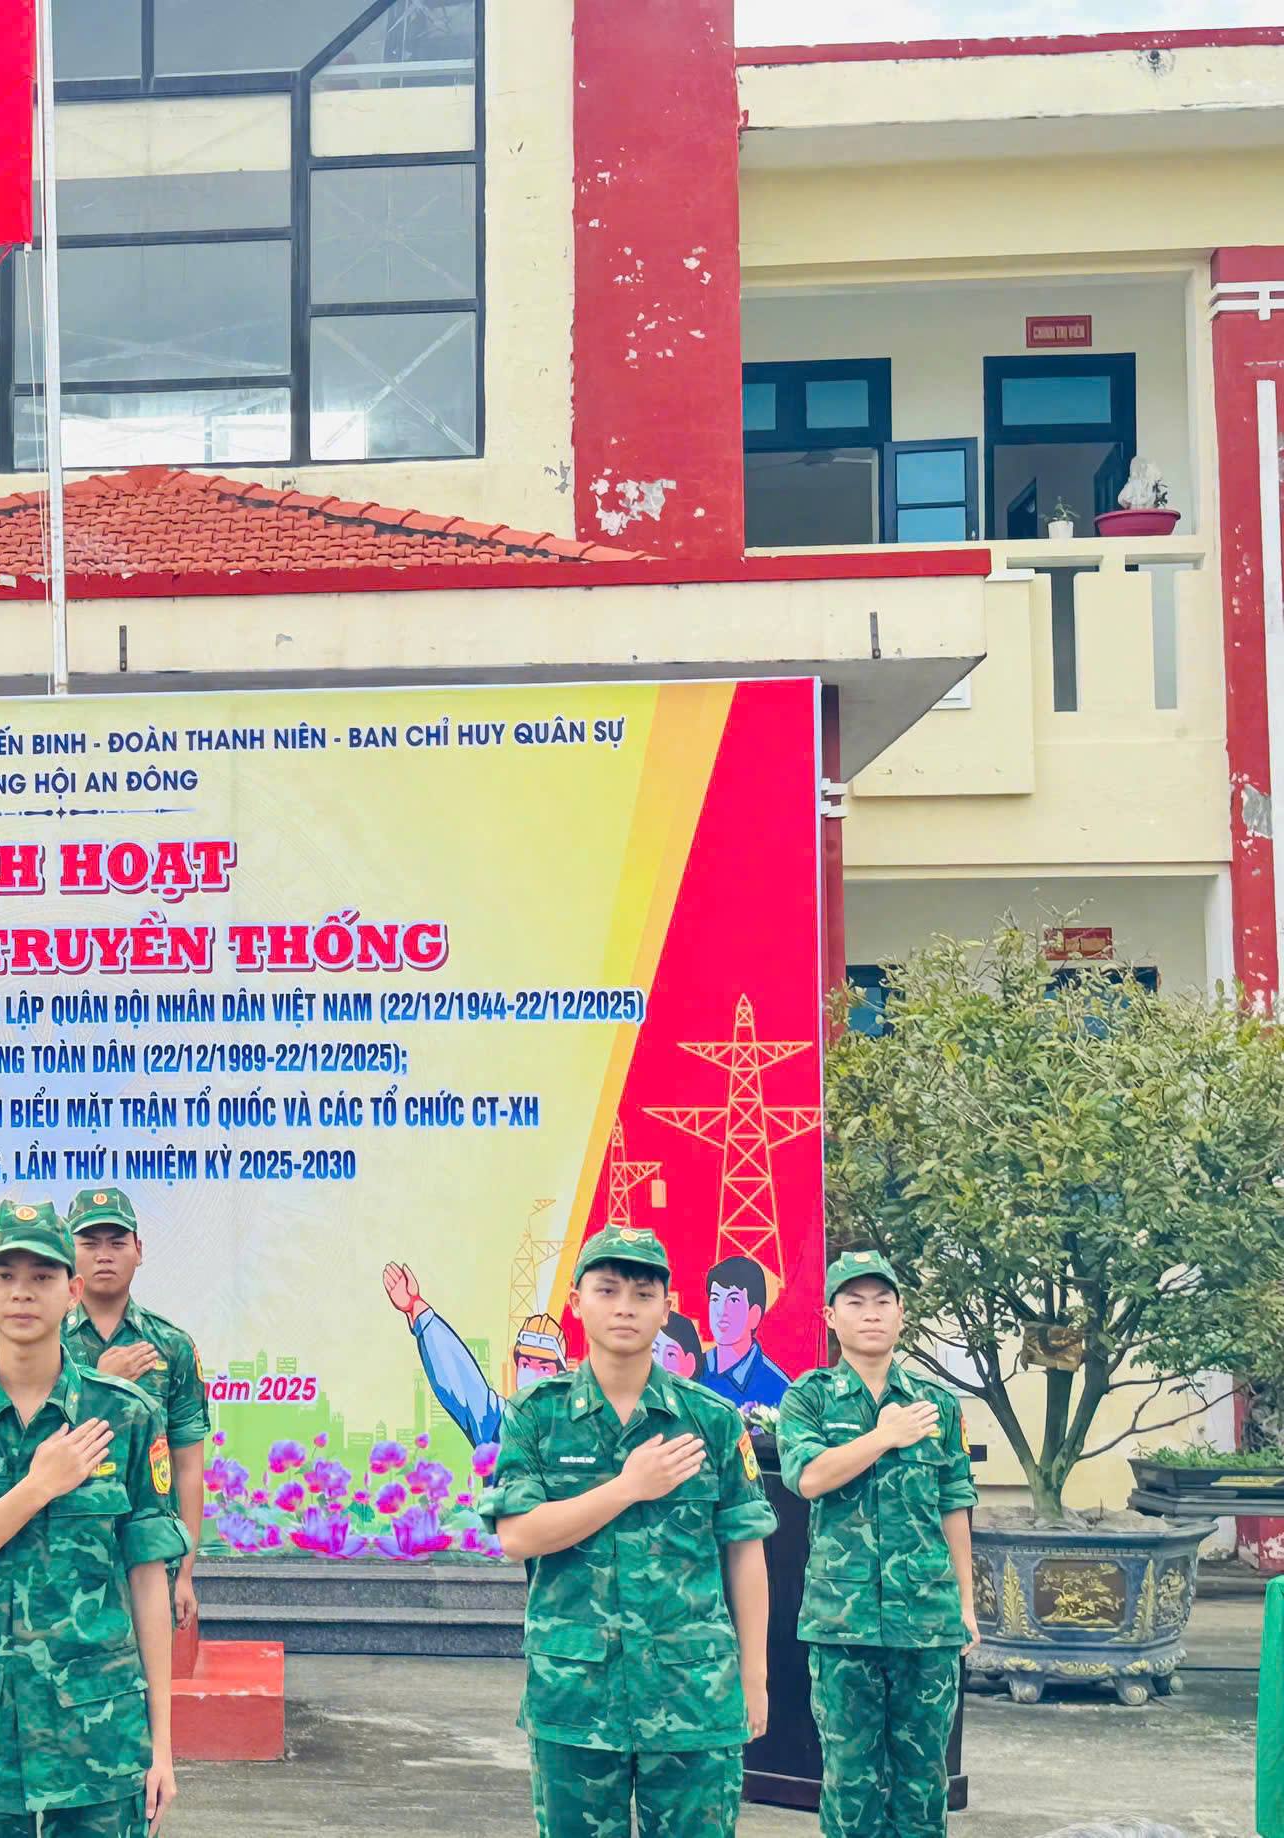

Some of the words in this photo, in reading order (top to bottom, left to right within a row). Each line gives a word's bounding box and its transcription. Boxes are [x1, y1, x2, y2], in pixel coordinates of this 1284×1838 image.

[32, 733, 86, 755] BINH
[107, 725, 177, 753] ĐOÀN
[185, 728, 265, 751] THANH
[273, 721, 326, 750] NIÊN
[348, 726, 397, 748] BAN
[405, 717, 449, 747] CHỈ
[457, 723, 506, 746] HUY
[513, 715, 585, 745] QUÂN
[593, 717, 625, 748] SỰ
[34, 766, 76, 800] HỘI
[84, 771, 118, 793] AN
[125, 764, 198, 792] ĐÔNG
[60, 841, 237, 904] HOẠT
[228, 910, 449, 973] THỐNG
[5, 989, 45, 1031] LẬP
[51, 988, 109, 1027] QUÂN
[114, 988, 150, 1030] ĐỘI
[156, 987, 216, 1023] NHÂN
[221, 987, 266, 1023] DÂN
[271, 986, 317, 1029] VIỆT
[323, 992, 373, 1022] NAM
[380, 990, 644, 1025] (22/12/1944-22/12/2025)
[30, 1038, 86, 1074] TOÀN
[92, 1038, 136, 1073] DÂN
[143, 1042, 408, 1076] (22/12/1989-22/12/2025);
[10, 1086, 60, 1129] BIỂU
[66, 1091, 114, 1135] MẶT
[119, 1090, 178, 1135] TRẬN
[183, 1085, 212, 1128] TỔ
[217, 1084, 277, 1131] QUỐC
[283, 1090, 313, 1127] VÀ
[318, 1090, 364, 1128] CÁC
[369, 1083, 398, 1127] TỔ
[404, 1089, 465, 1127] CHỨC
[472, 1096, 539, 1127] CT-XH
[14, 1139, 57, 1181] LẦN
[63, 1143, 107, 1181] THỨ
[111, 1150, 119, 1180] I
[125, 1143, 198, 1187] NHIỆM
[204, 1143, 233, 1180] KỲ
[239, 1149, 356, 1180] 2025-2030
[258, 1377, 317, 1401] 2025
